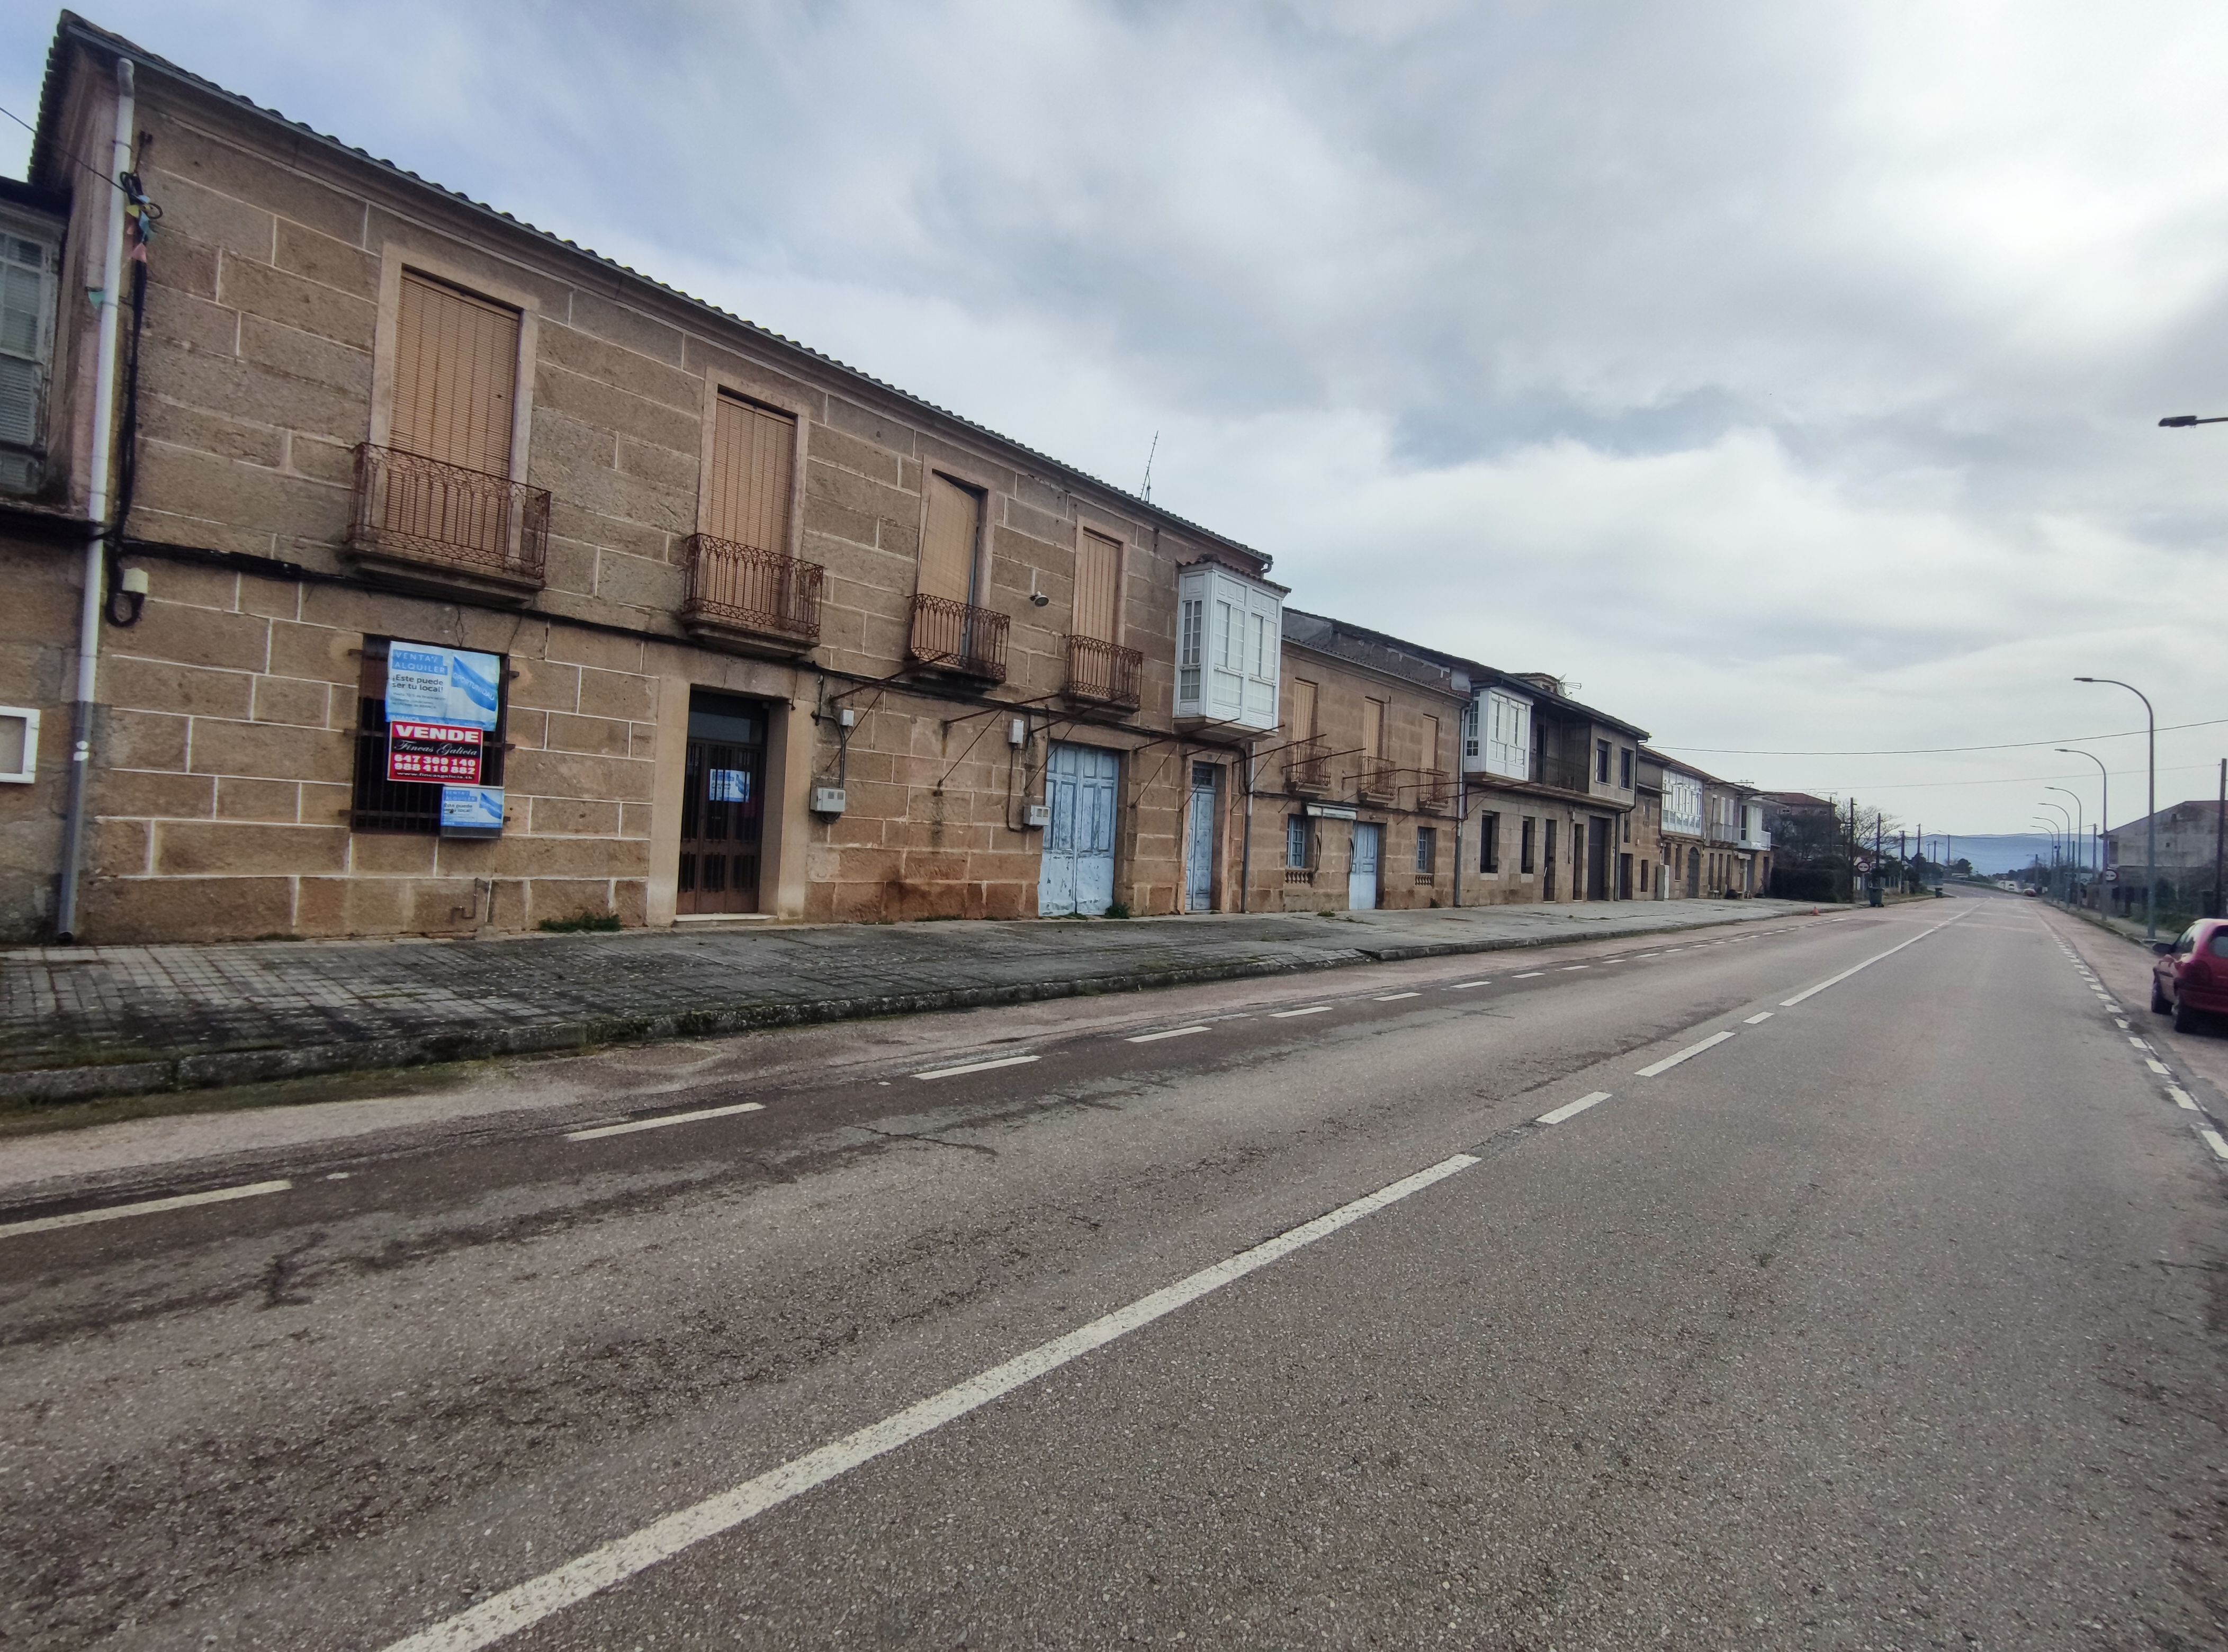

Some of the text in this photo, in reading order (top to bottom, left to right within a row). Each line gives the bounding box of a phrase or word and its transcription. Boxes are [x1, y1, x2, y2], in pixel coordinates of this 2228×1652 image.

[396, 652, 430, 661] VENTA
[394, 662, 445, 673] ALQUILER
[396, 724, 479, 743] VENDE
[394, 740, 477, 756] Fincas Galicia
[394, 754, 421, 763] 647
[452, 758, 475, 767] 140
[394, 762, 421, 771] 988
[423, 764, 448, 773] 410
